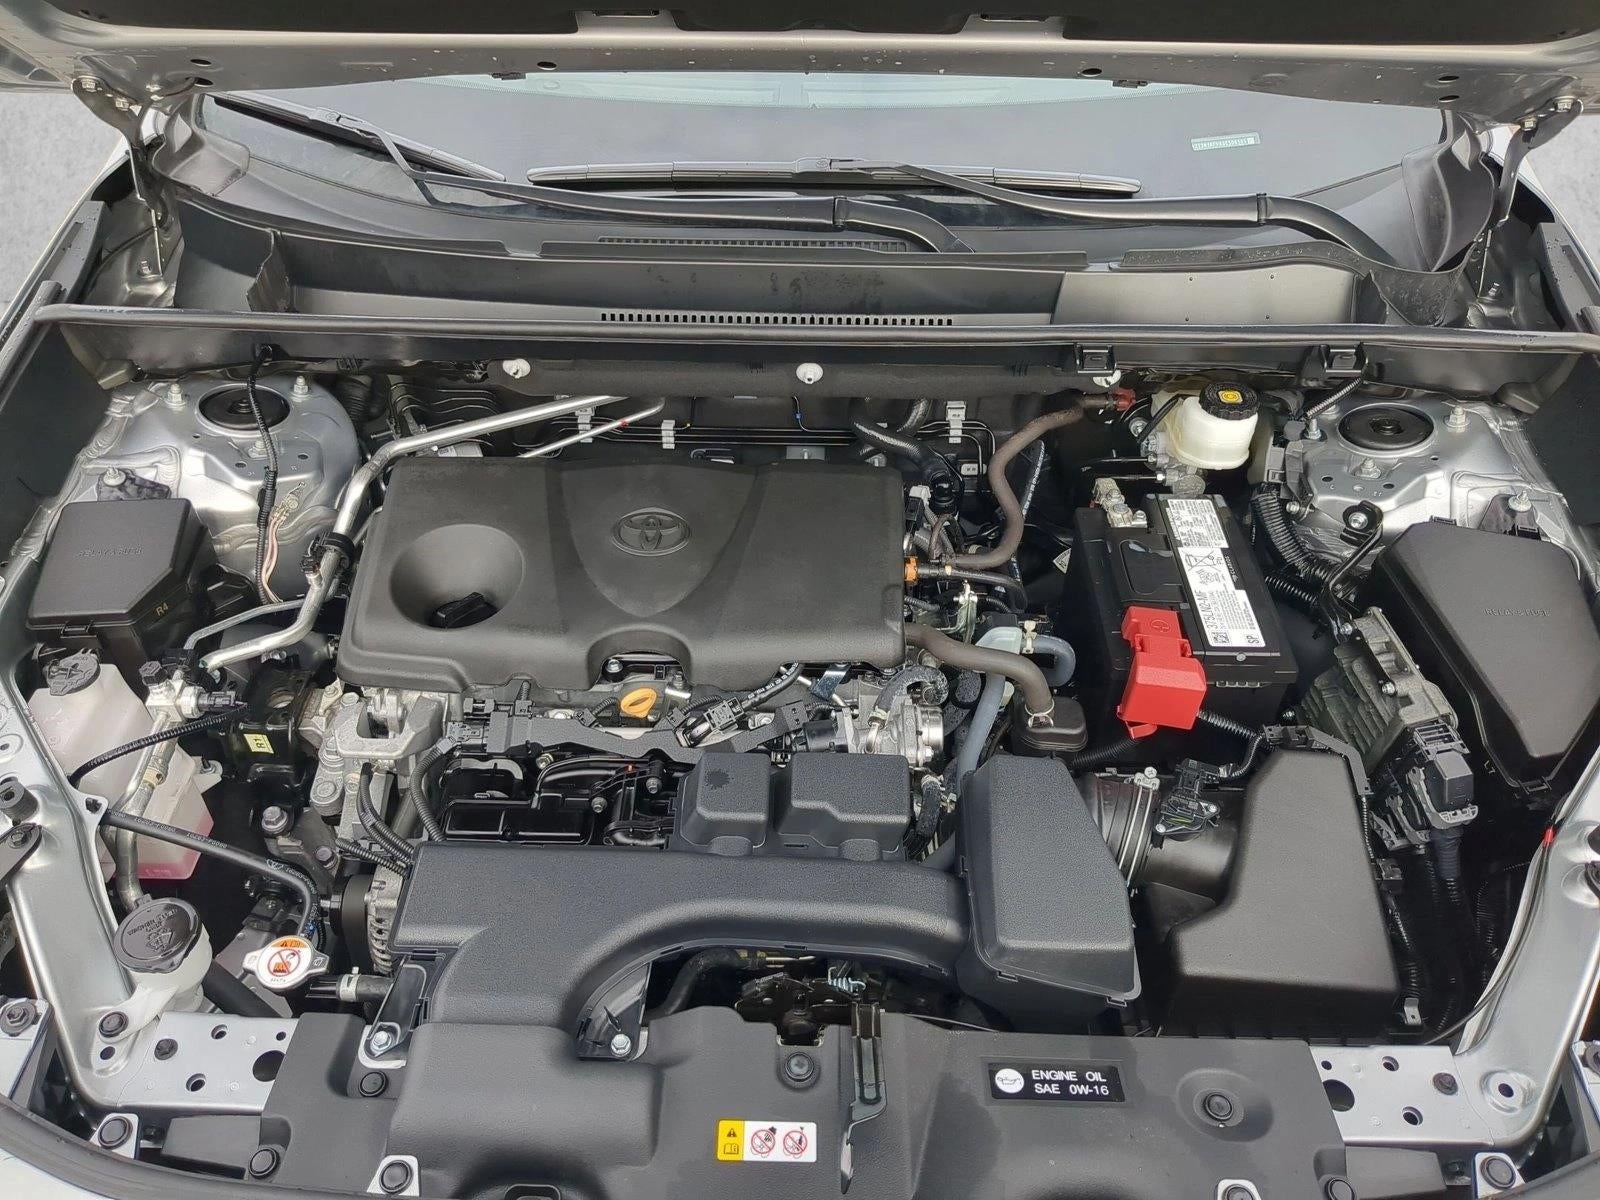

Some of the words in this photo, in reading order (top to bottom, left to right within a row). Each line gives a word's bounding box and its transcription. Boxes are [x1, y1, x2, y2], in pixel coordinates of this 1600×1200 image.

[155, 602, 169, 616] R4
[1248, 635, 1260, 644] SP
[1031, 1069, 1078, 1081] ENGINE
[1085, 1071, 1107, 1082] OIL
[1034, 1083, 1061, 1094] SAE
[1069, 1084, 1109, 1096] 0W-16
